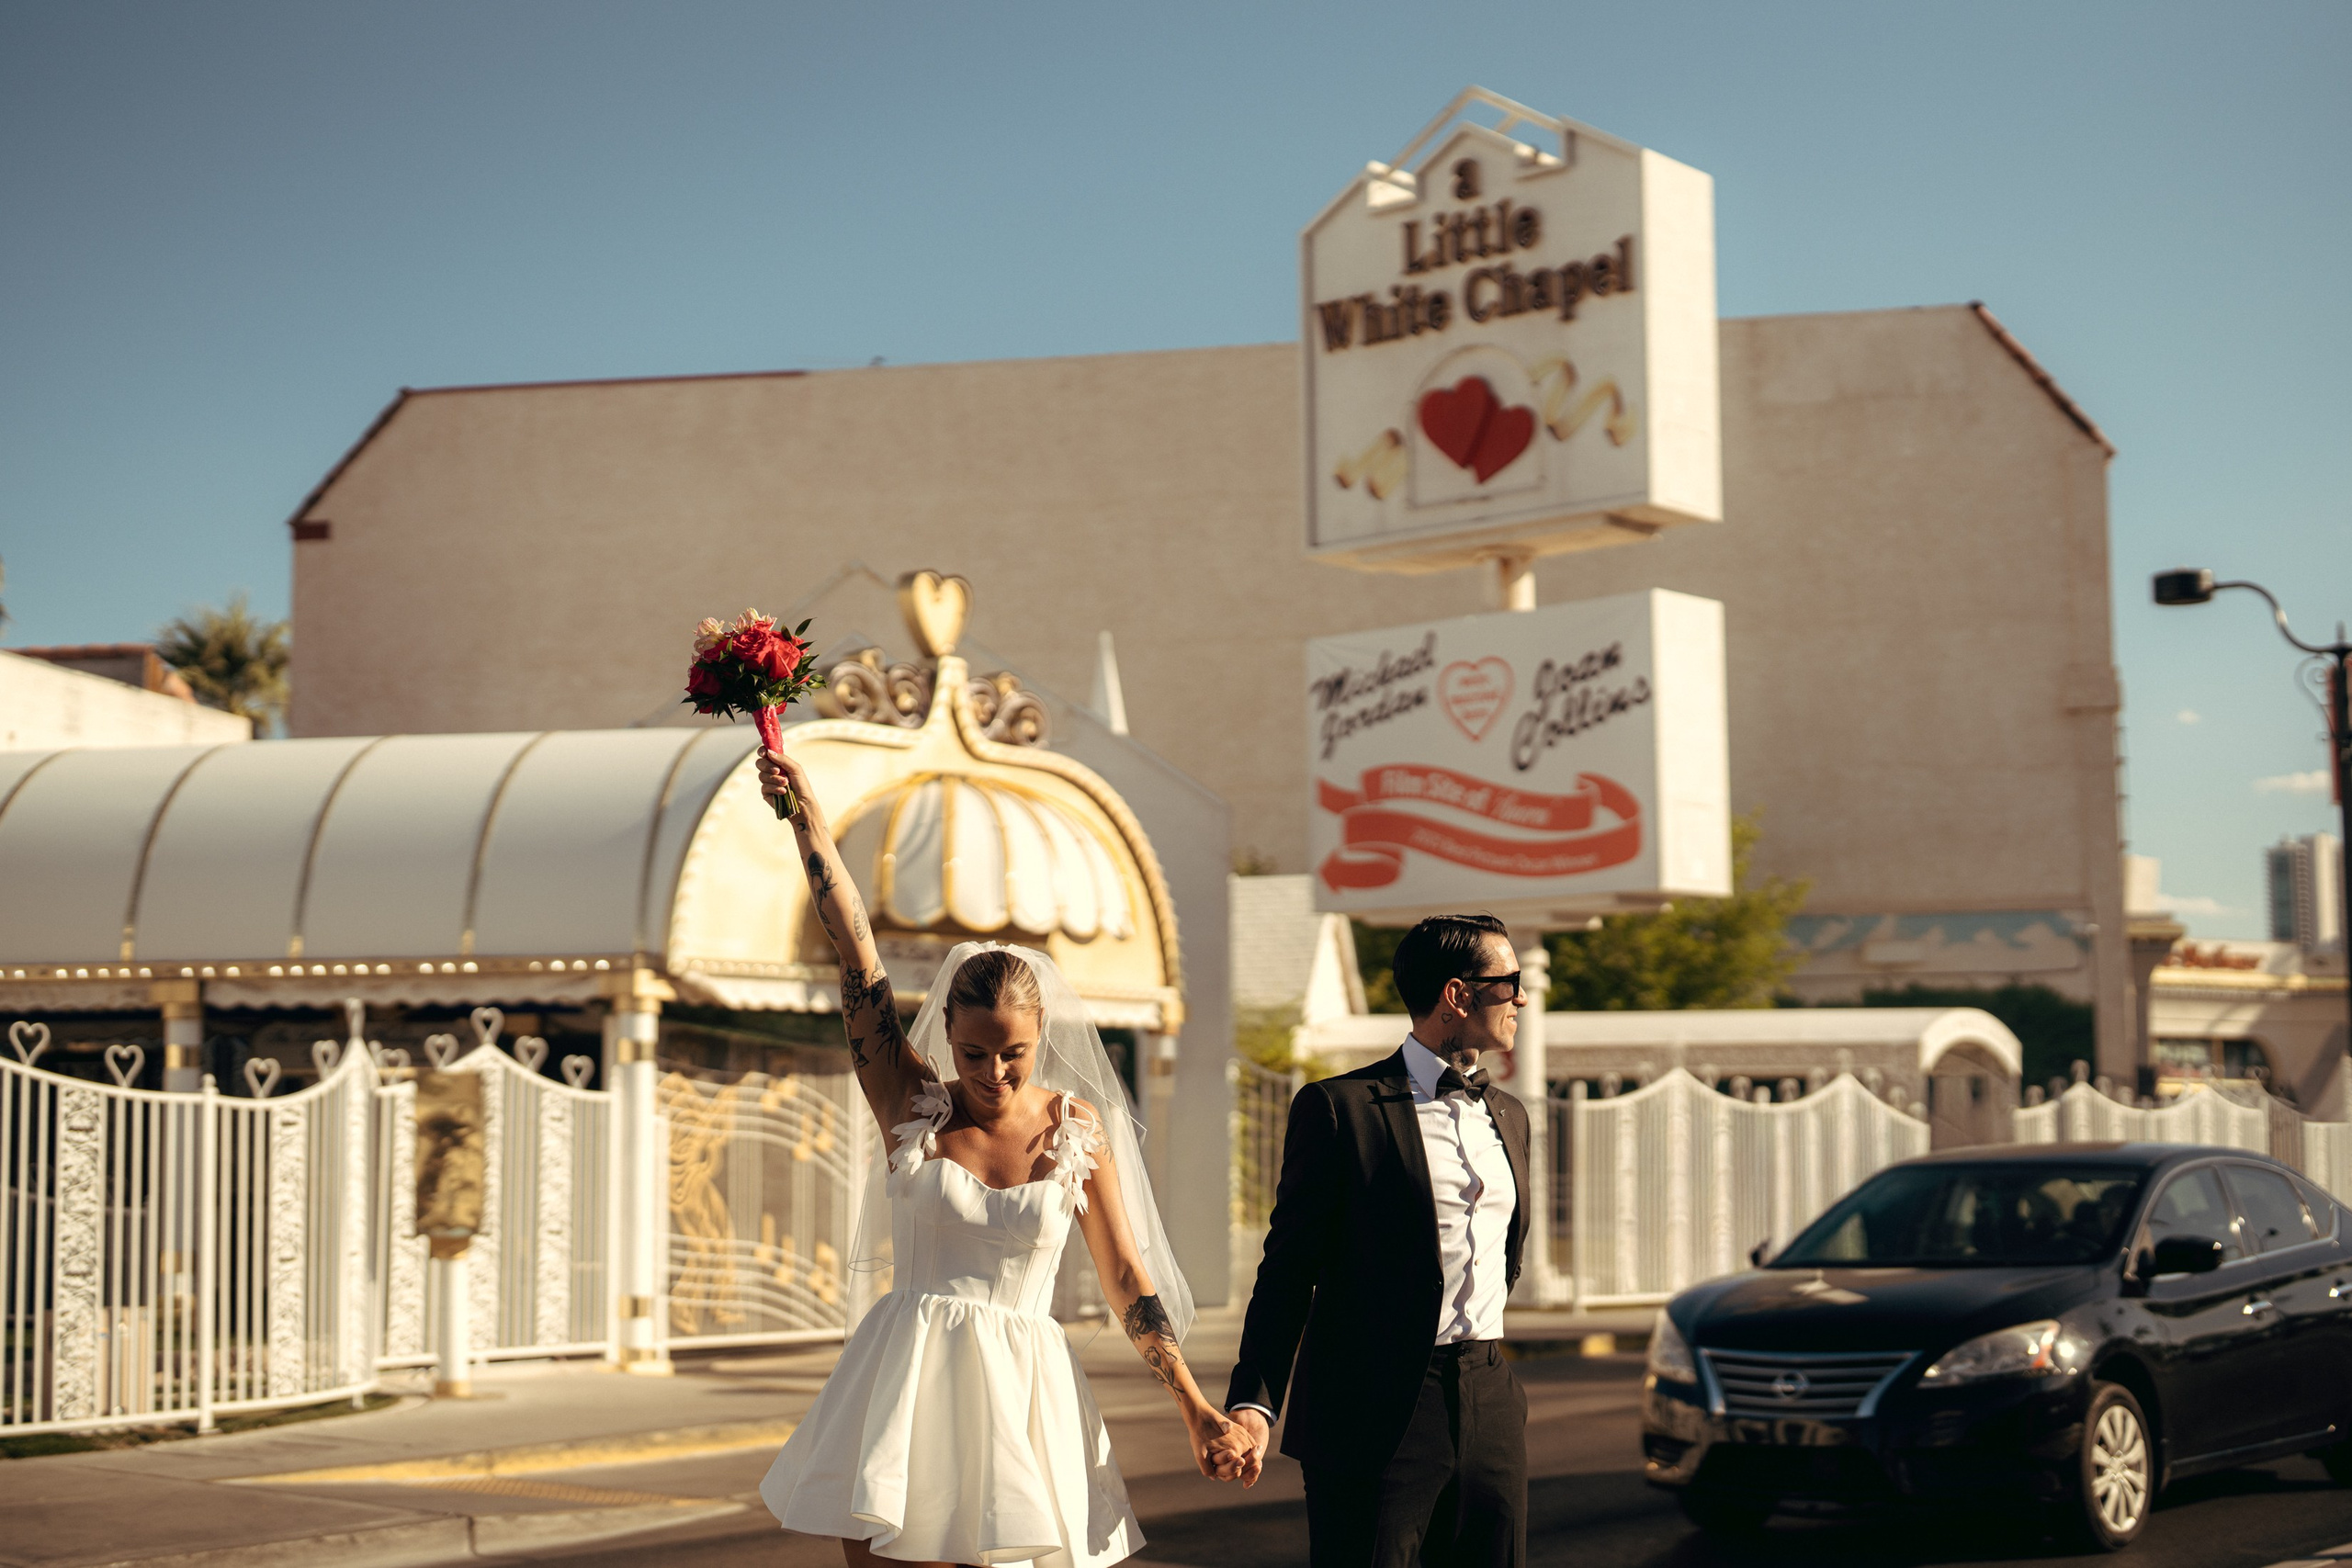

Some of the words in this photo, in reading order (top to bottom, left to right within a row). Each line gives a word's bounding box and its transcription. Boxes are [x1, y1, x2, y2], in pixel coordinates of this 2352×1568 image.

[1403, 198, 1541, 275] Little
[1316, 283, 1452, 352] White
[1464, 235, 1634, 321] Chapel
[1321, 686, 1429, 761] Jordan
[1510, 676, 1651, 772] Collins
[1535, 641, 1621, 724] Joan
